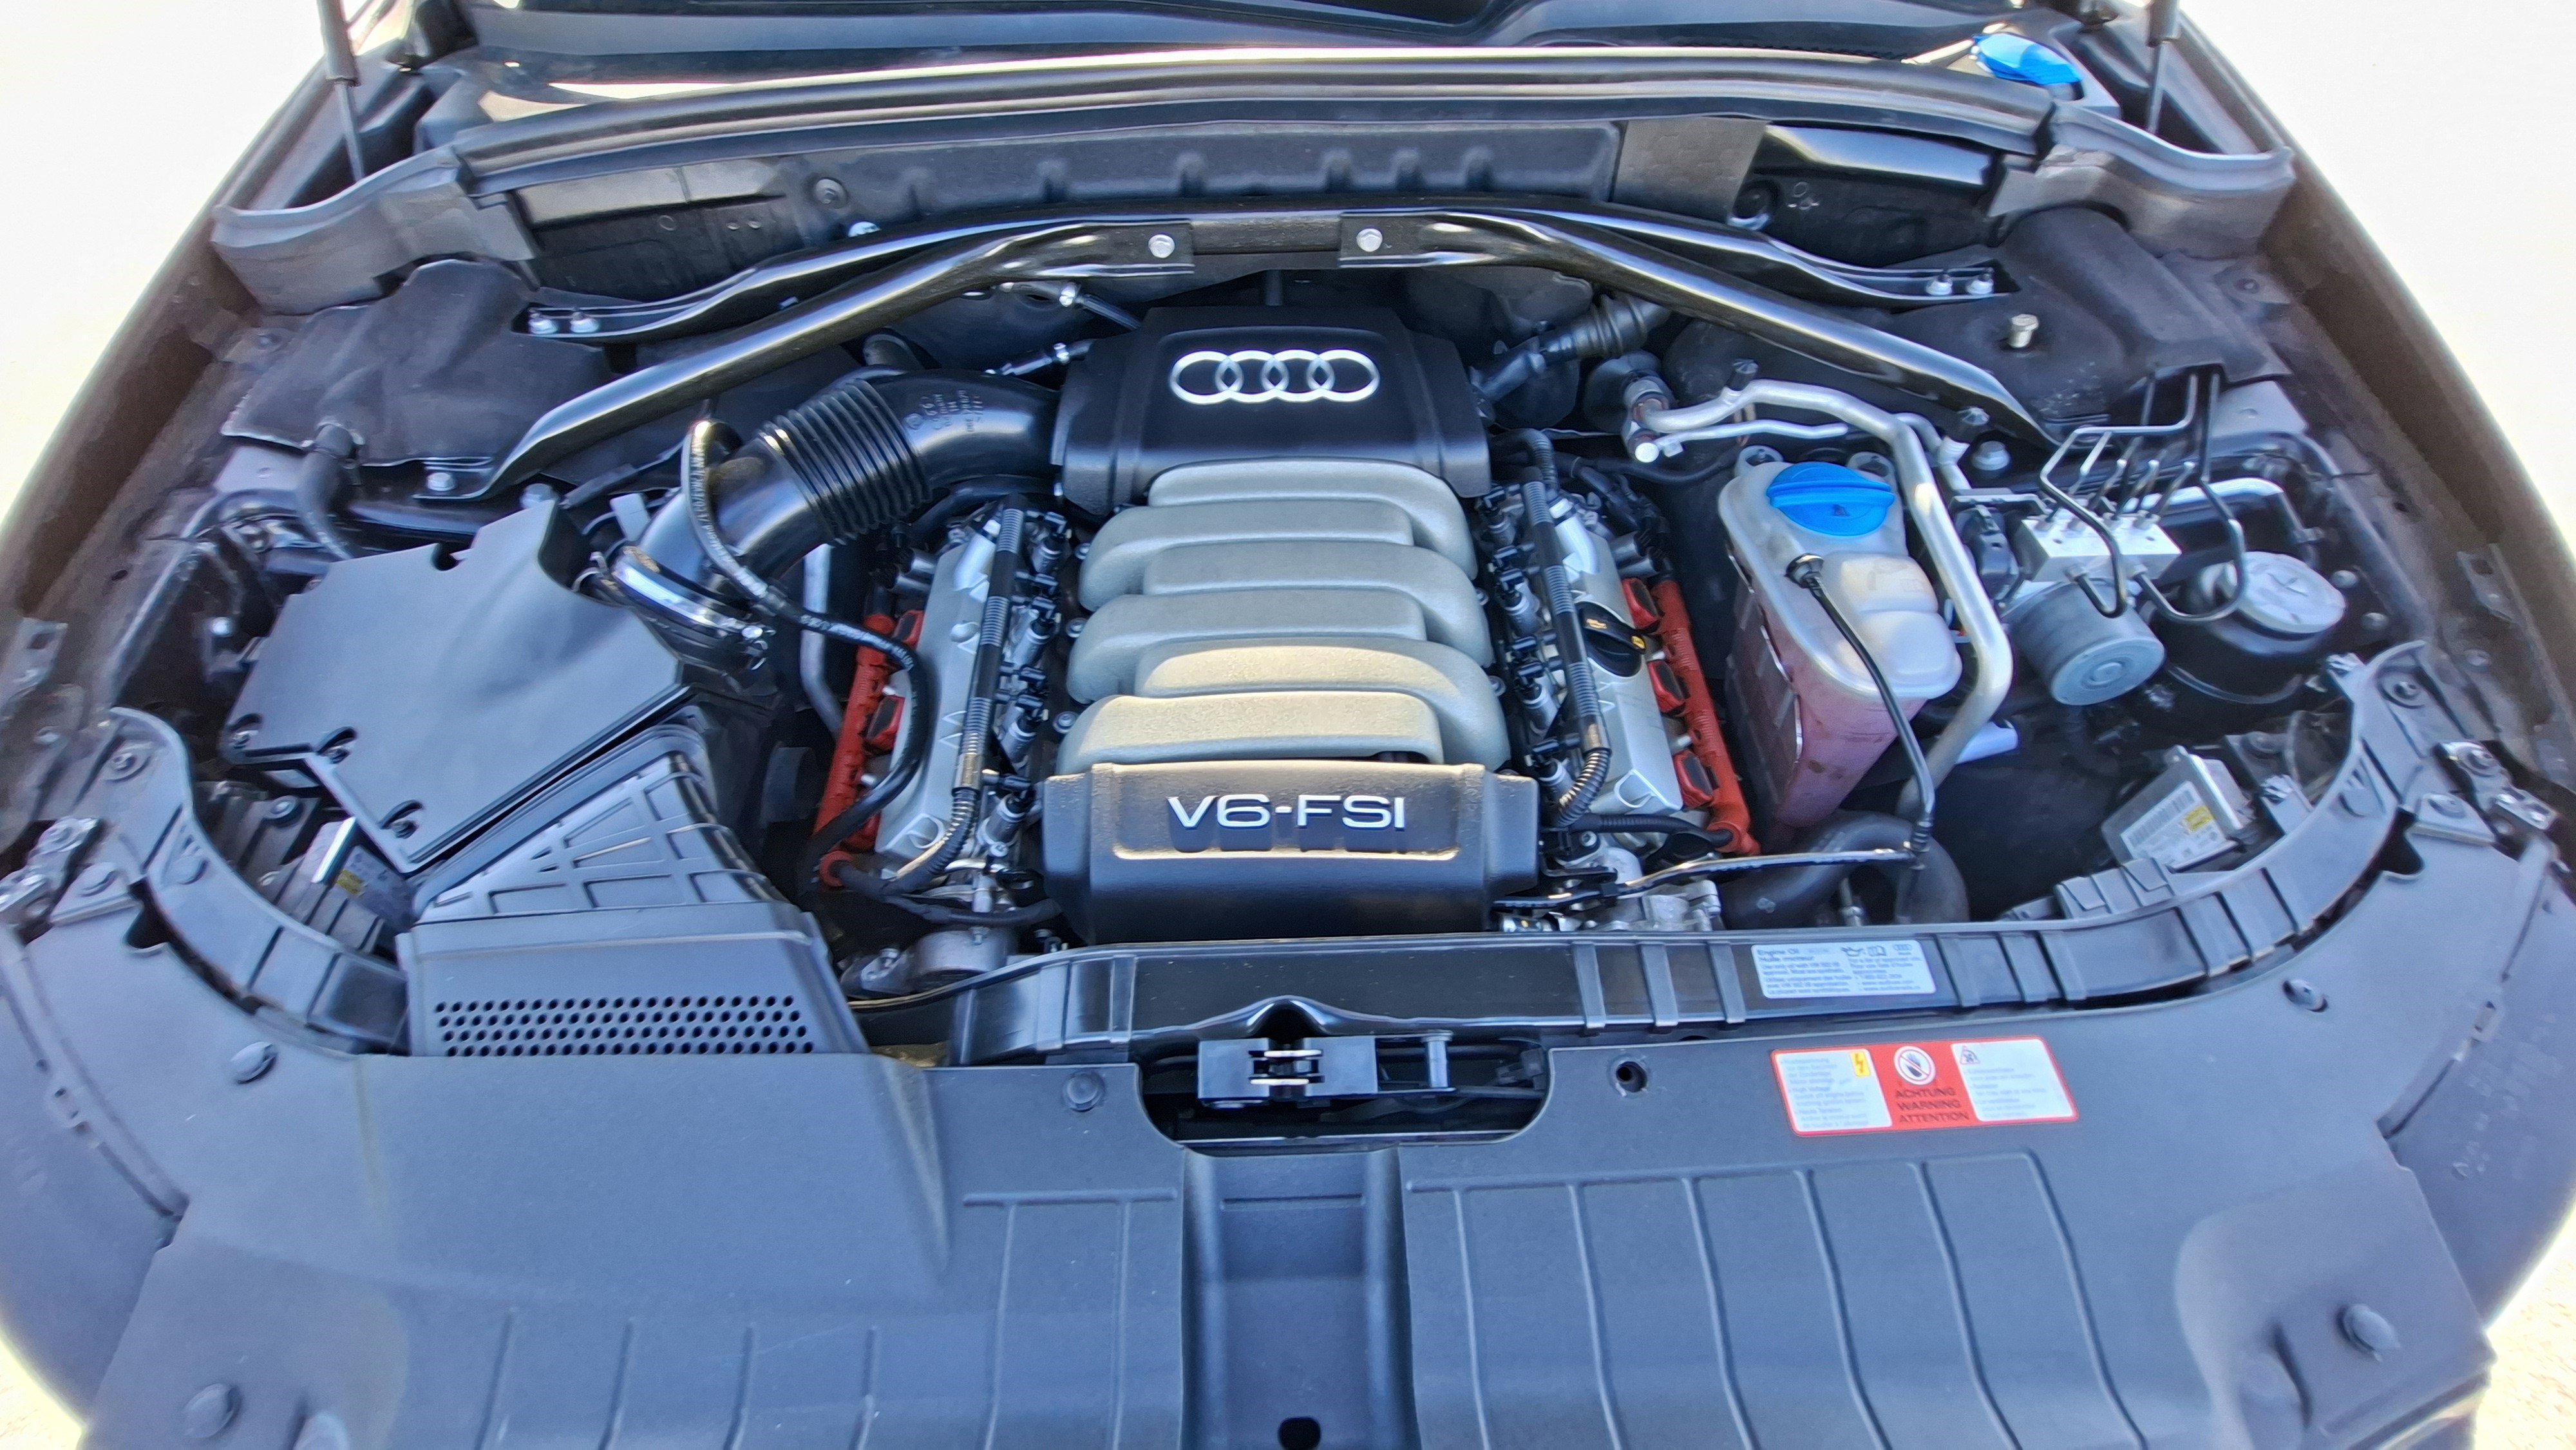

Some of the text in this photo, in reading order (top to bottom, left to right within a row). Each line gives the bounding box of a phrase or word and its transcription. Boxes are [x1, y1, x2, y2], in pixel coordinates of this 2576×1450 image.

[1167, 793, 1405, 828] V6-FSI
[1895, 1087, 1955, 1098] ACHTUNG
[1897, 1098, 1961, 1111] WARNING
[1899, 1111, 1970, 1123] ATTENTION
